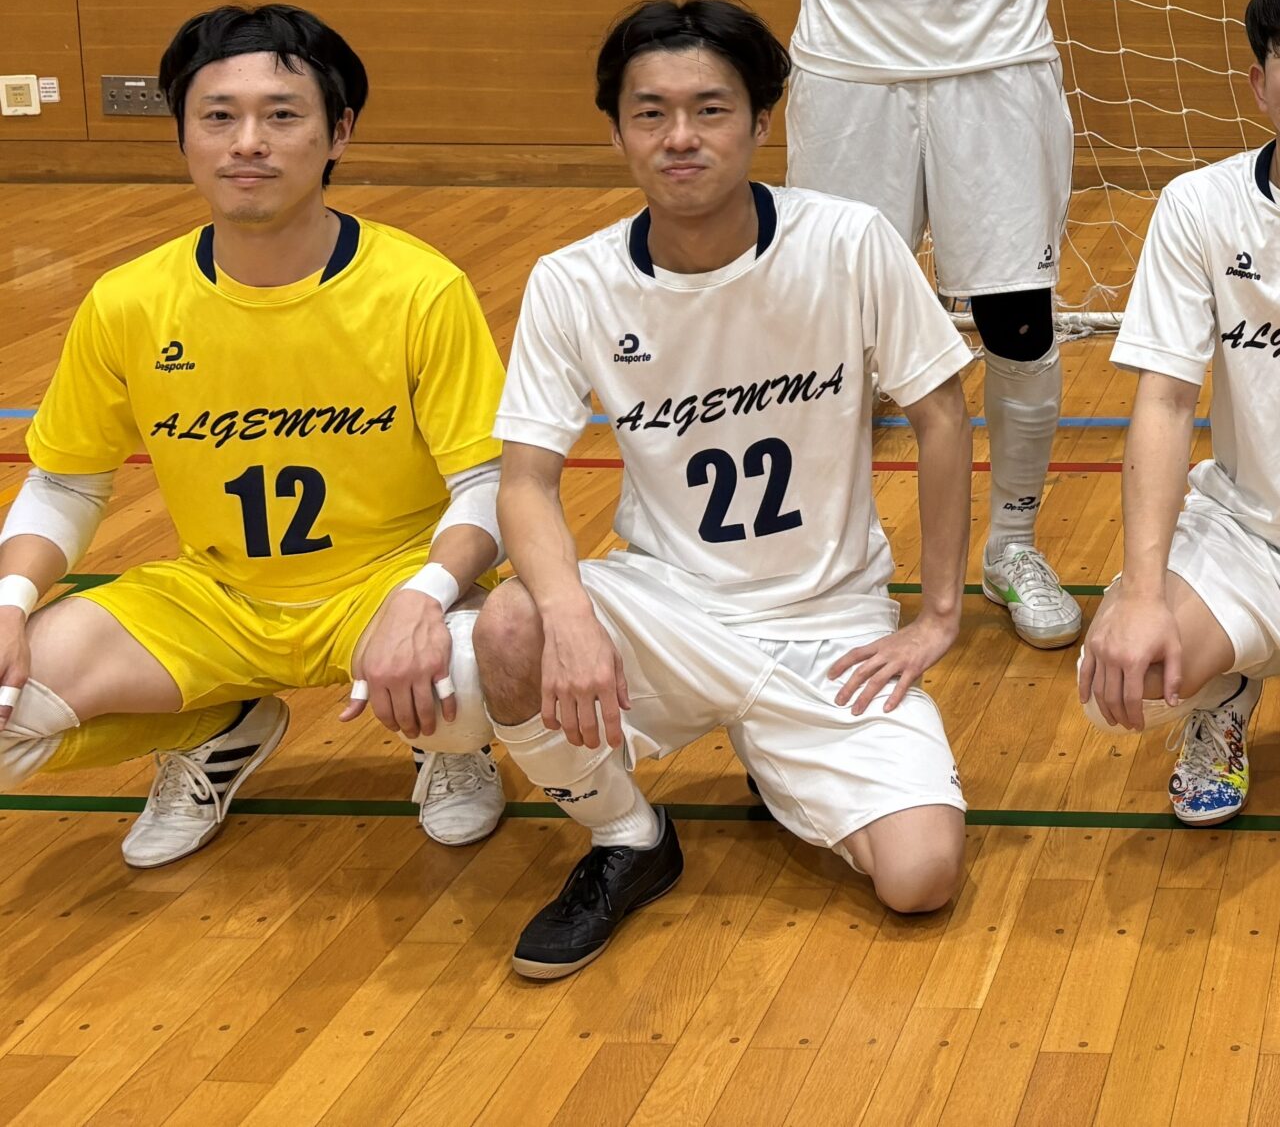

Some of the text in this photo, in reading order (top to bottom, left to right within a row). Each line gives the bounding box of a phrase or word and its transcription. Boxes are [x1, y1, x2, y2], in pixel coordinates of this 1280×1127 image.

[155, 360, 195, 374] Desporte
[614, 352, 651, 365] Desporte
[150, 405, 397, 448] ALGEMMA
[617, 363, 844, 437] ALGEMMA
[224, 464, 333, 558] 12
[686, 437, 803, 544] 22
